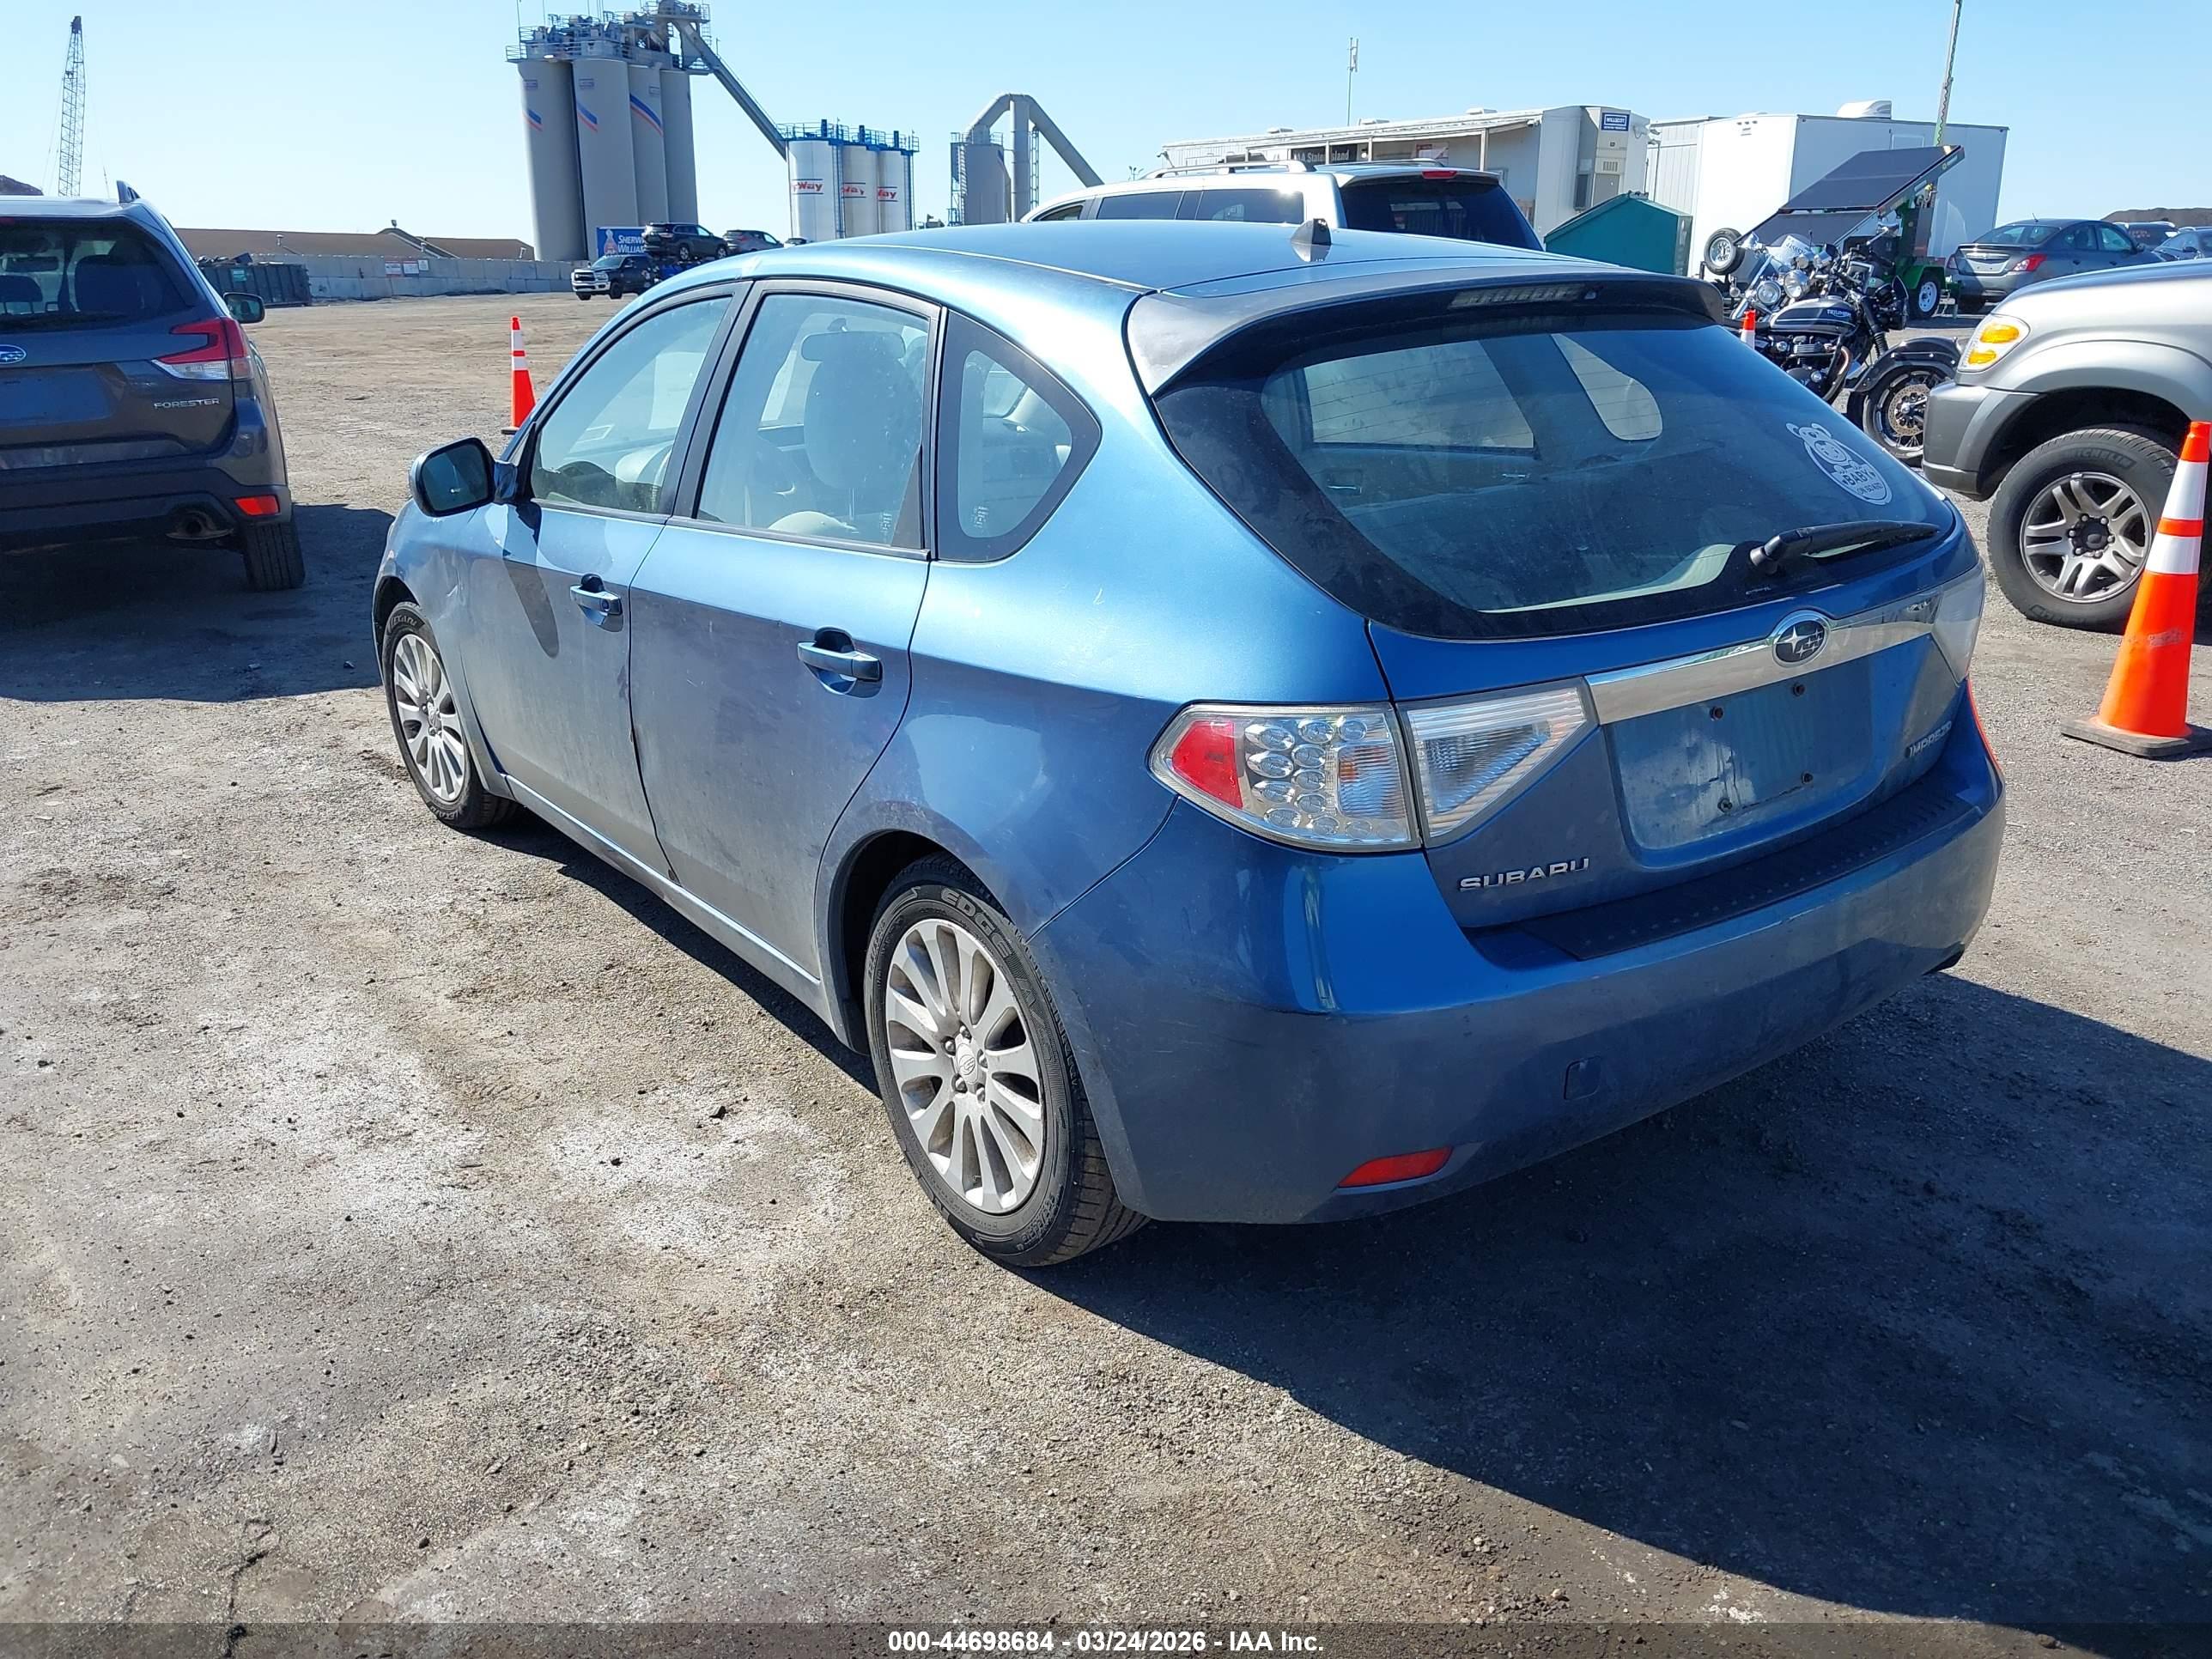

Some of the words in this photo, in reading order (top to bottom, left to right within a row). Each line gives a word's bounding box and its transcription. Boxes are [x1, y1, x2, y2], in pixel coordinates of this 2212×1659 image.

[1307, 151, 1326, 162] State
[1331, 149, 1350, 161] sland
[153, 398, 220, 410] FORESTER
[1843, 469, 1873, 486] BABY
[1908, 720, 1952, 758] IMPREZA
[1459, 858, 1589, 892] SUBARU
[940, 887, 1014, 958] EDGE
